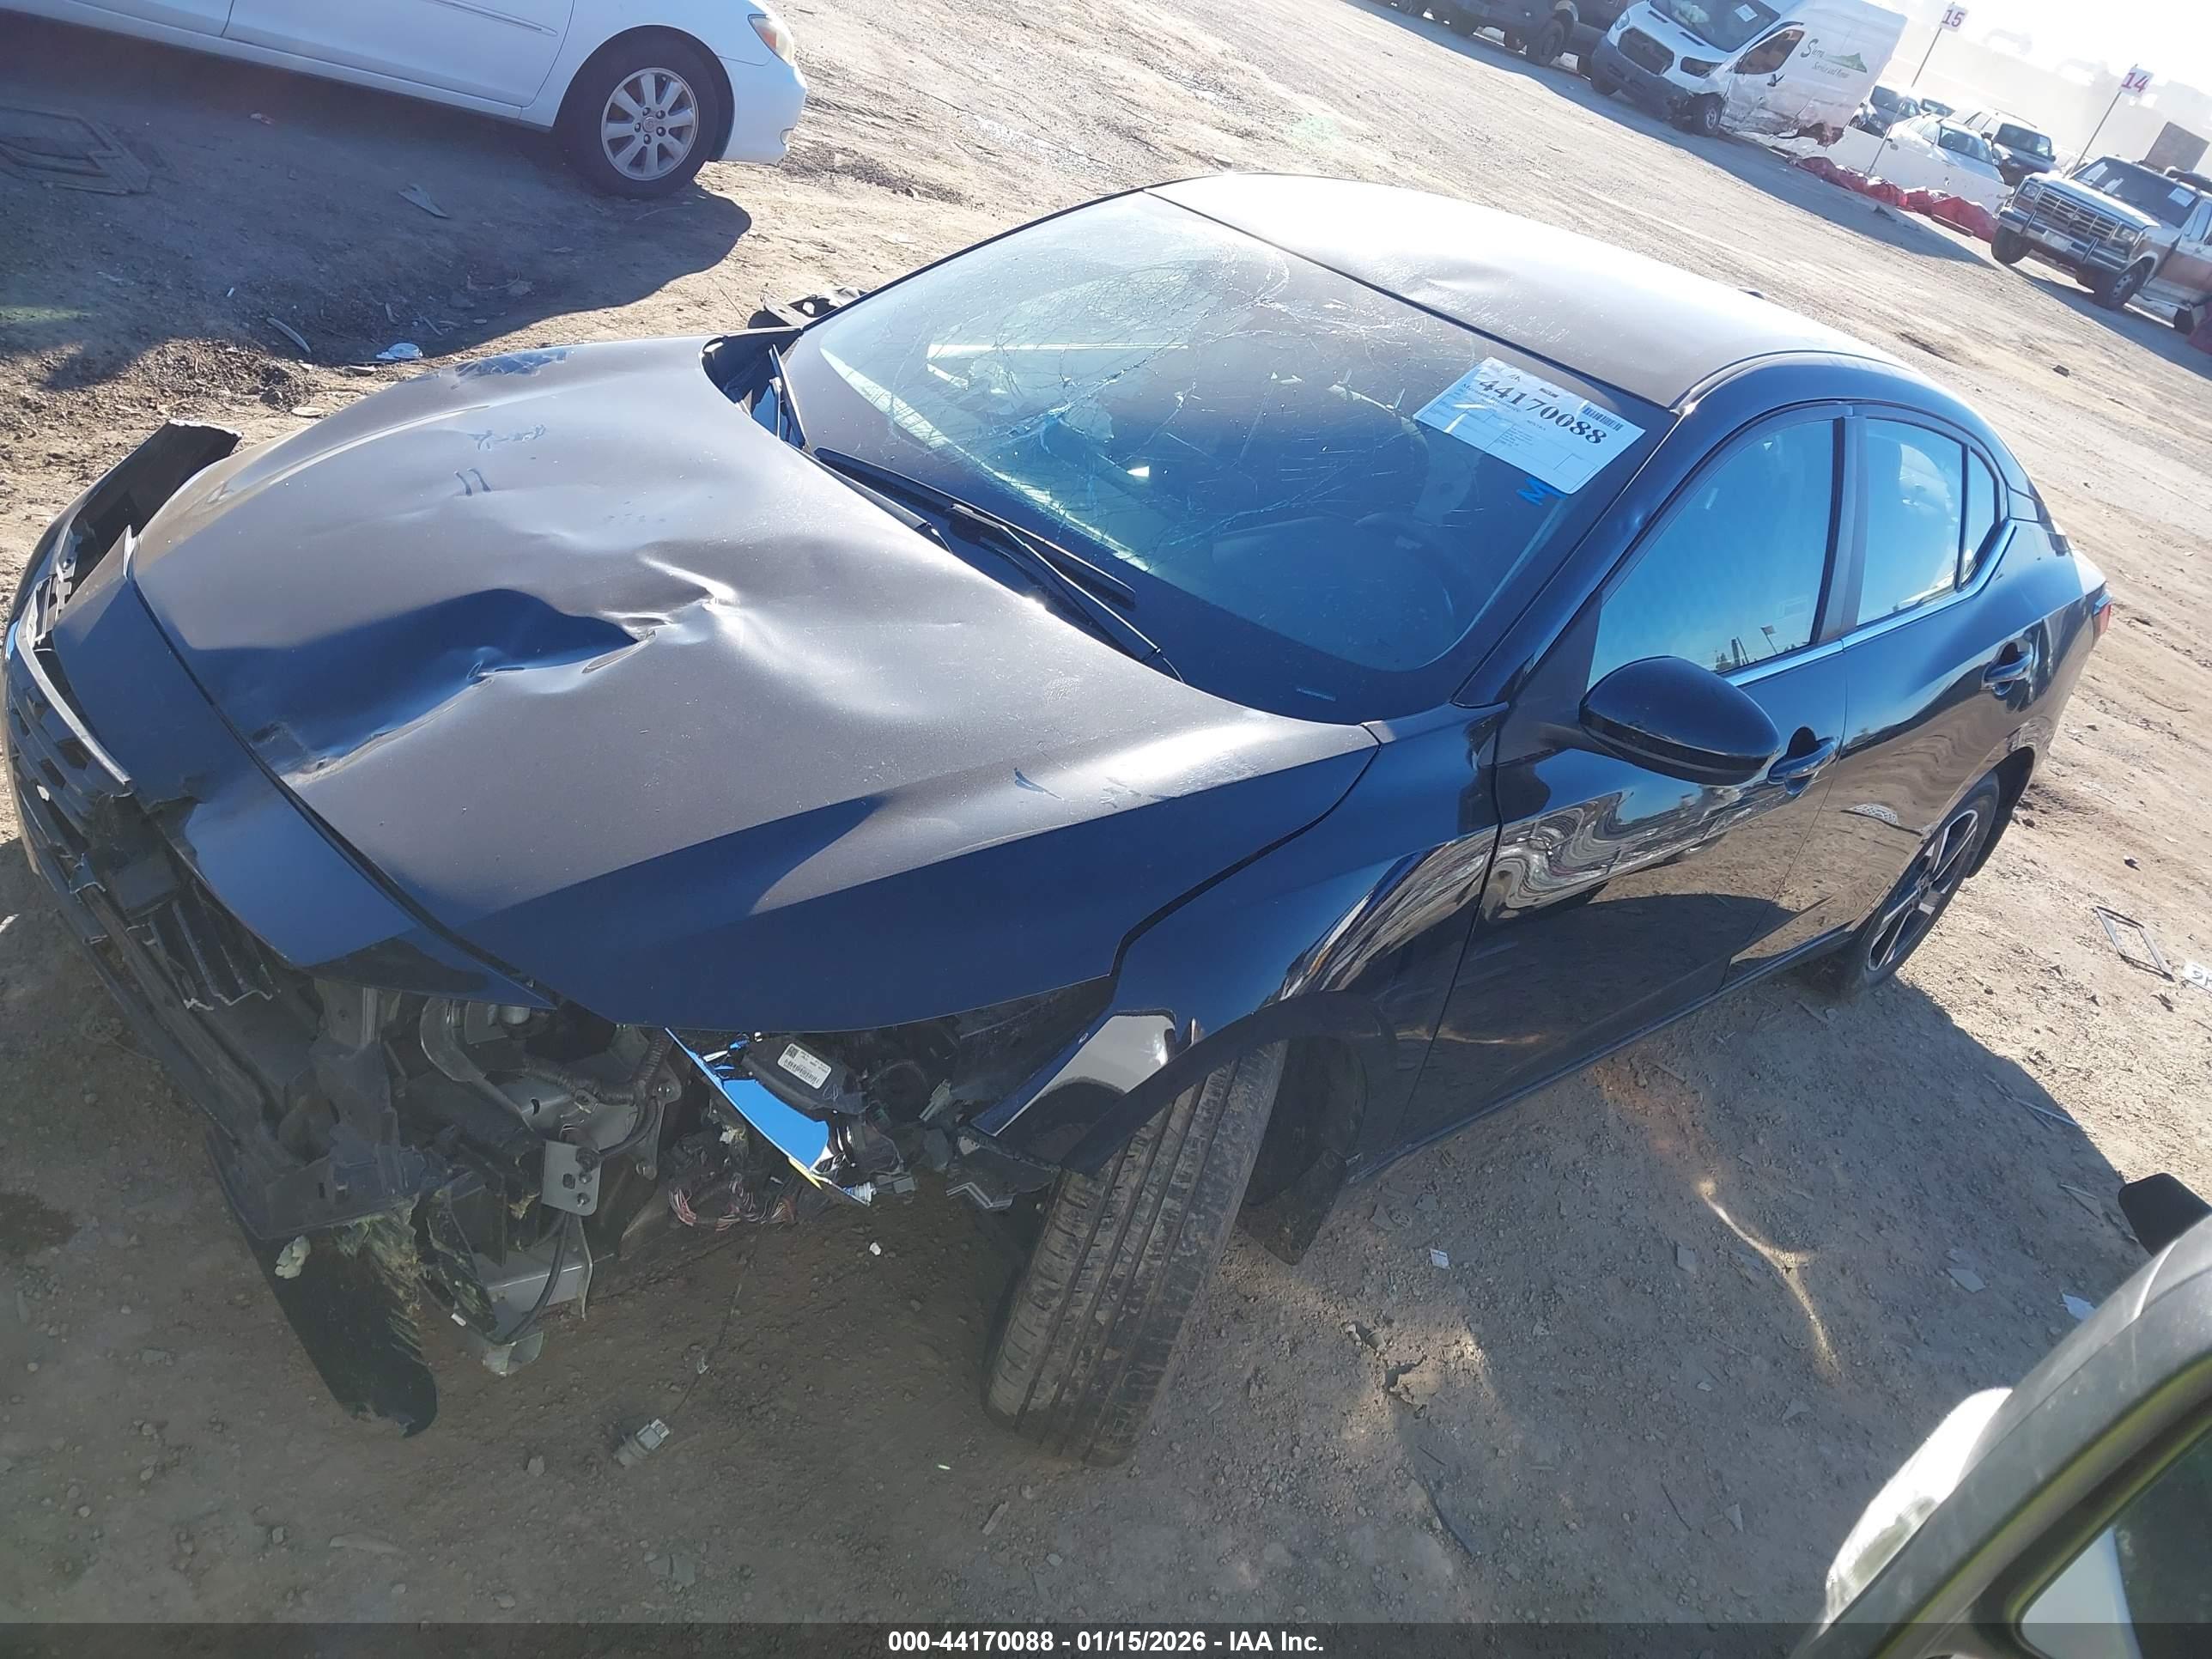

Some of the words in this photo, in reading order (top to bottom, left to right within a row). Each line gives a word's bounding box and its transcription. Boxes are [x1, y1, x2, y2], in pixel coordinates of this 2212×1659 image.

[1942, 9, 1966, 27] 15
[2121, 72, 2149, 93] 14
[1478, 380, 1607, 445] 44170088
